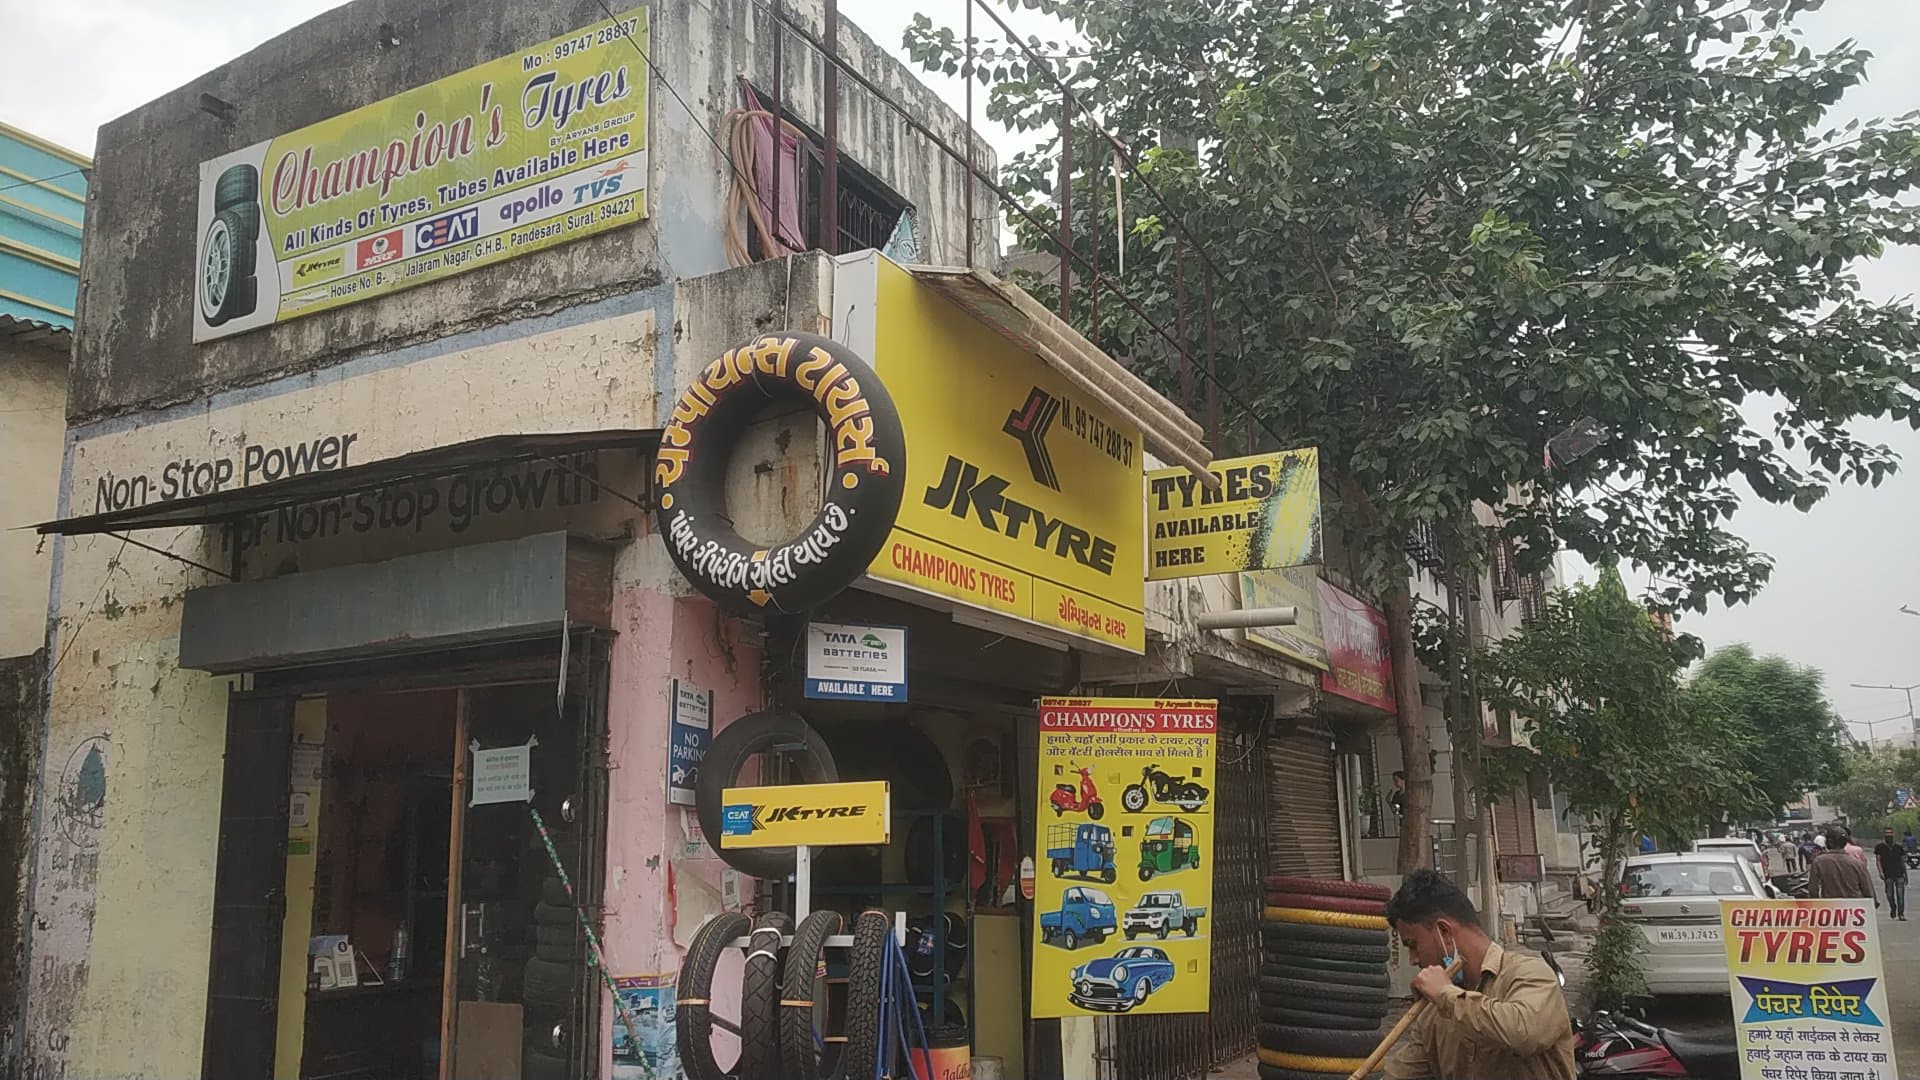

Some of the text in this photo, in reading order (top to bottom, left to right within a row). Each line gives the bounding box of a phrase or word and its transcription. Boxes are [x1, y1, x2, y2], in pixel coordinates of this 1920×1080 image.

[523, 56, 542, 71] Mo
[554, 35, 593, 60] 99747
[598, 18, 638, 45] 28837
[603, 113, 636, 129] GROUP
[271, 66, 631, 215] Champion's Tyres
[284, 132, 630, 252] All Kinds Of Tyres, Tubes Available Here
[500, 186, 563, 223] apollo
[573, 174, 624, 205] TVS
[418, 209, 479, 250] CEAT
[331, 283, 357, 299] House
[359, 276, 374, 290] No.
[405, 252, 441, 279] Jalaram
[443, 244, 473, 267] Nagar,
[511, 220, 565, 247] Pandesara,
[568, 212, 597, 232] Surat.
[600, 197, 636, 218] 394221
[1075, 406, 1087, 440] 99
[1089, 415, 1104, 450] 747
[243, 432, 358, 487] Power
[1151, 464, 1274, 511] TYRES
[277, 487, 438, 543] Non-Stop
[1155, 511, 1260, 540] AVAILABLE
[1155, 546, 1205, 568] HERE
[892, 542, 1016, 604] CHAMPIONS TYRES
[823, 632, 857, 644] TATA
[1105, 616, 1127, 640] ટાયર
[817, 681, 895, 697] AVAILABLE HERE
[1043, 711, 1214, 729] CHAMPION'S TYRES
[684, 731, 699, 747] NO
[728, 810, 750, 820] CEAT
[1731, 908, 1866, 927] CHAMPION'S
[1738, 931, 1867, 964] TYRES
[1755, 985, 1862, 1016] पंचर रिपेर
[1748, 1026, 1772, 1043] हमारे
[1797, 1026, 1837, 1044] साईकल
[1839, 1027, 1850, 1042] से
[1852, 1028, 1881, 1043] लेकर
[1746, 1045, 1888, 1063] हवाई जहाज तक के टायर का
[1761, 1066, 1782, 1080] पंचर
[1785, 1066, 1808, 1080] रिपेर
